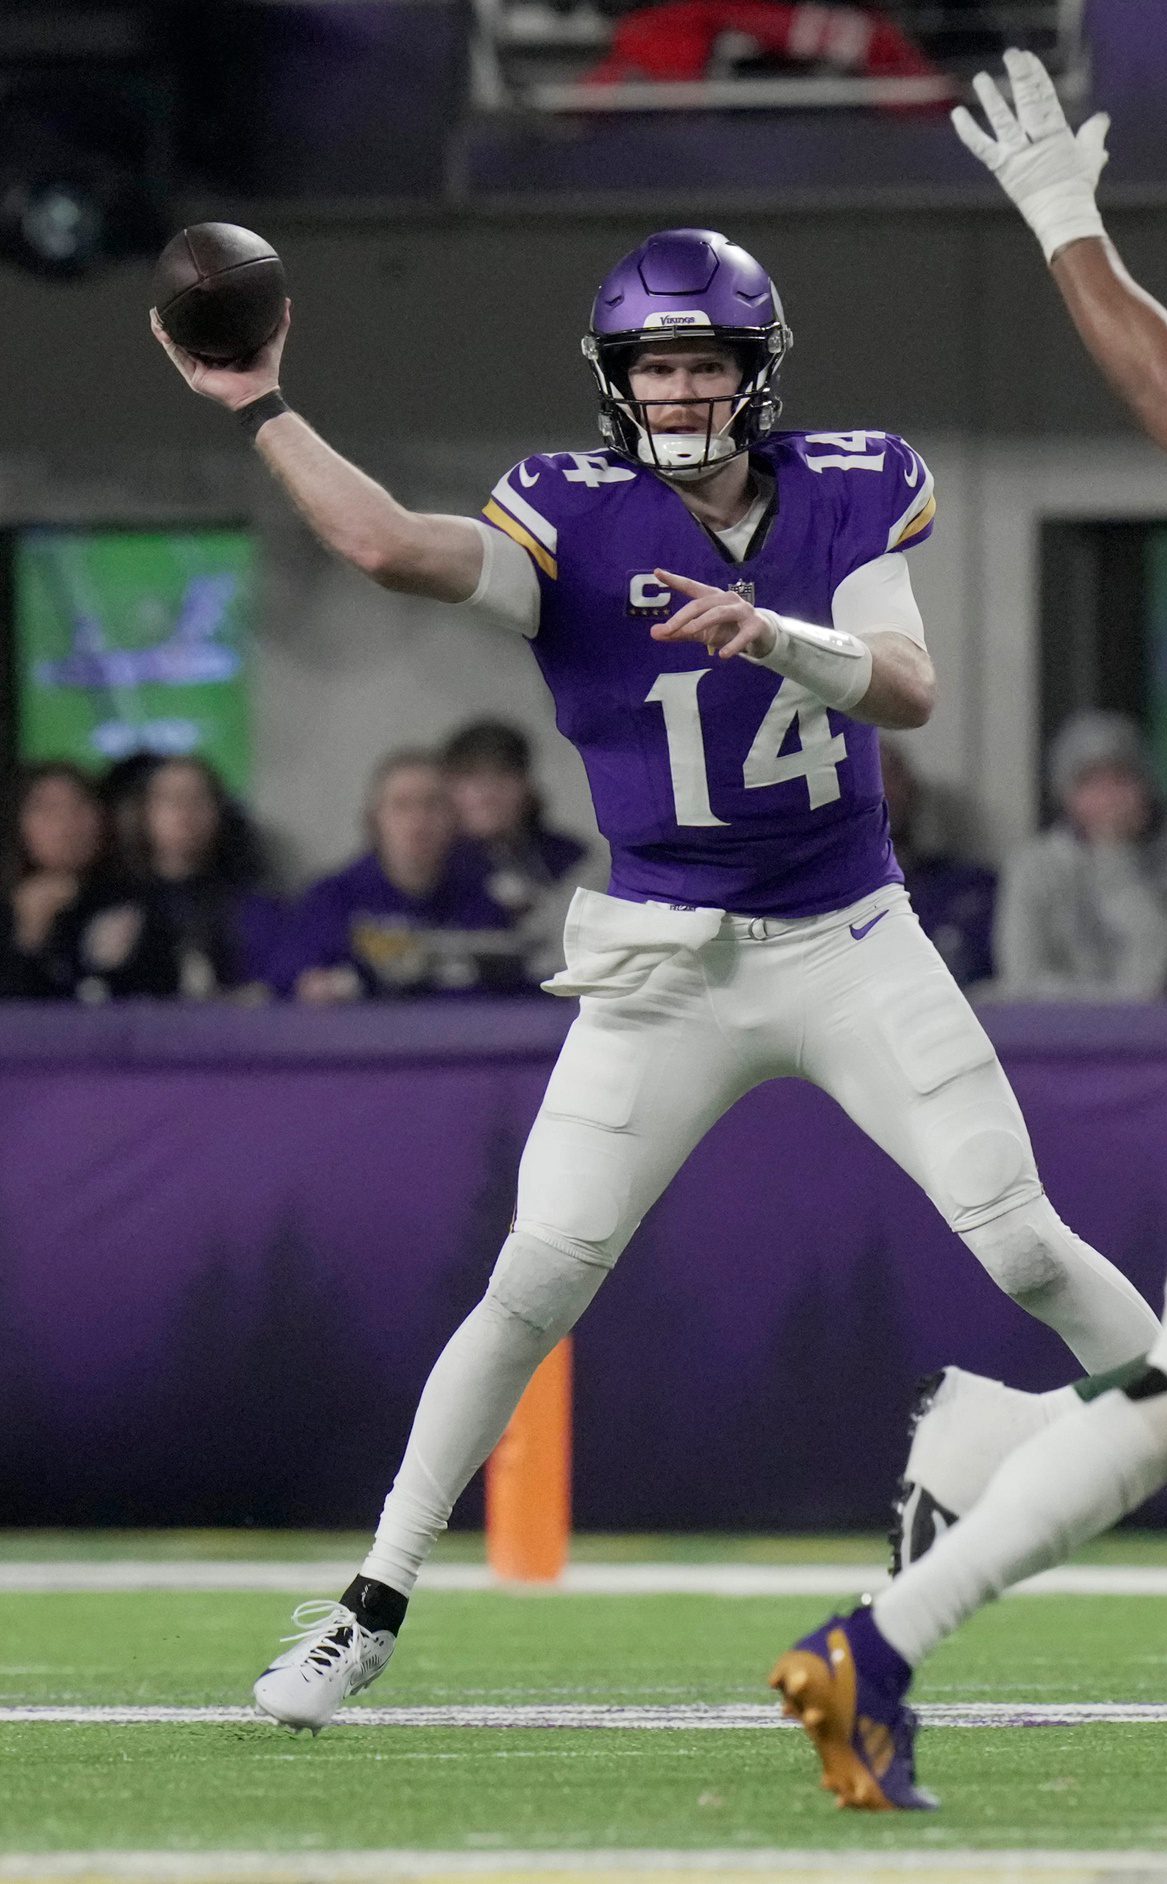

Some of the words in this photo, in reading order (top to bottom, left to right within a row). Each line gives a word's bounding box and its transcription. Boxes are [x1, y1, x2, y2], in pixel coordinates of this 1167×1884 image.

[805, 430, 886, 473] 14
[630, 574, 671, 607] C
[644, 668, 847, 828] 14
